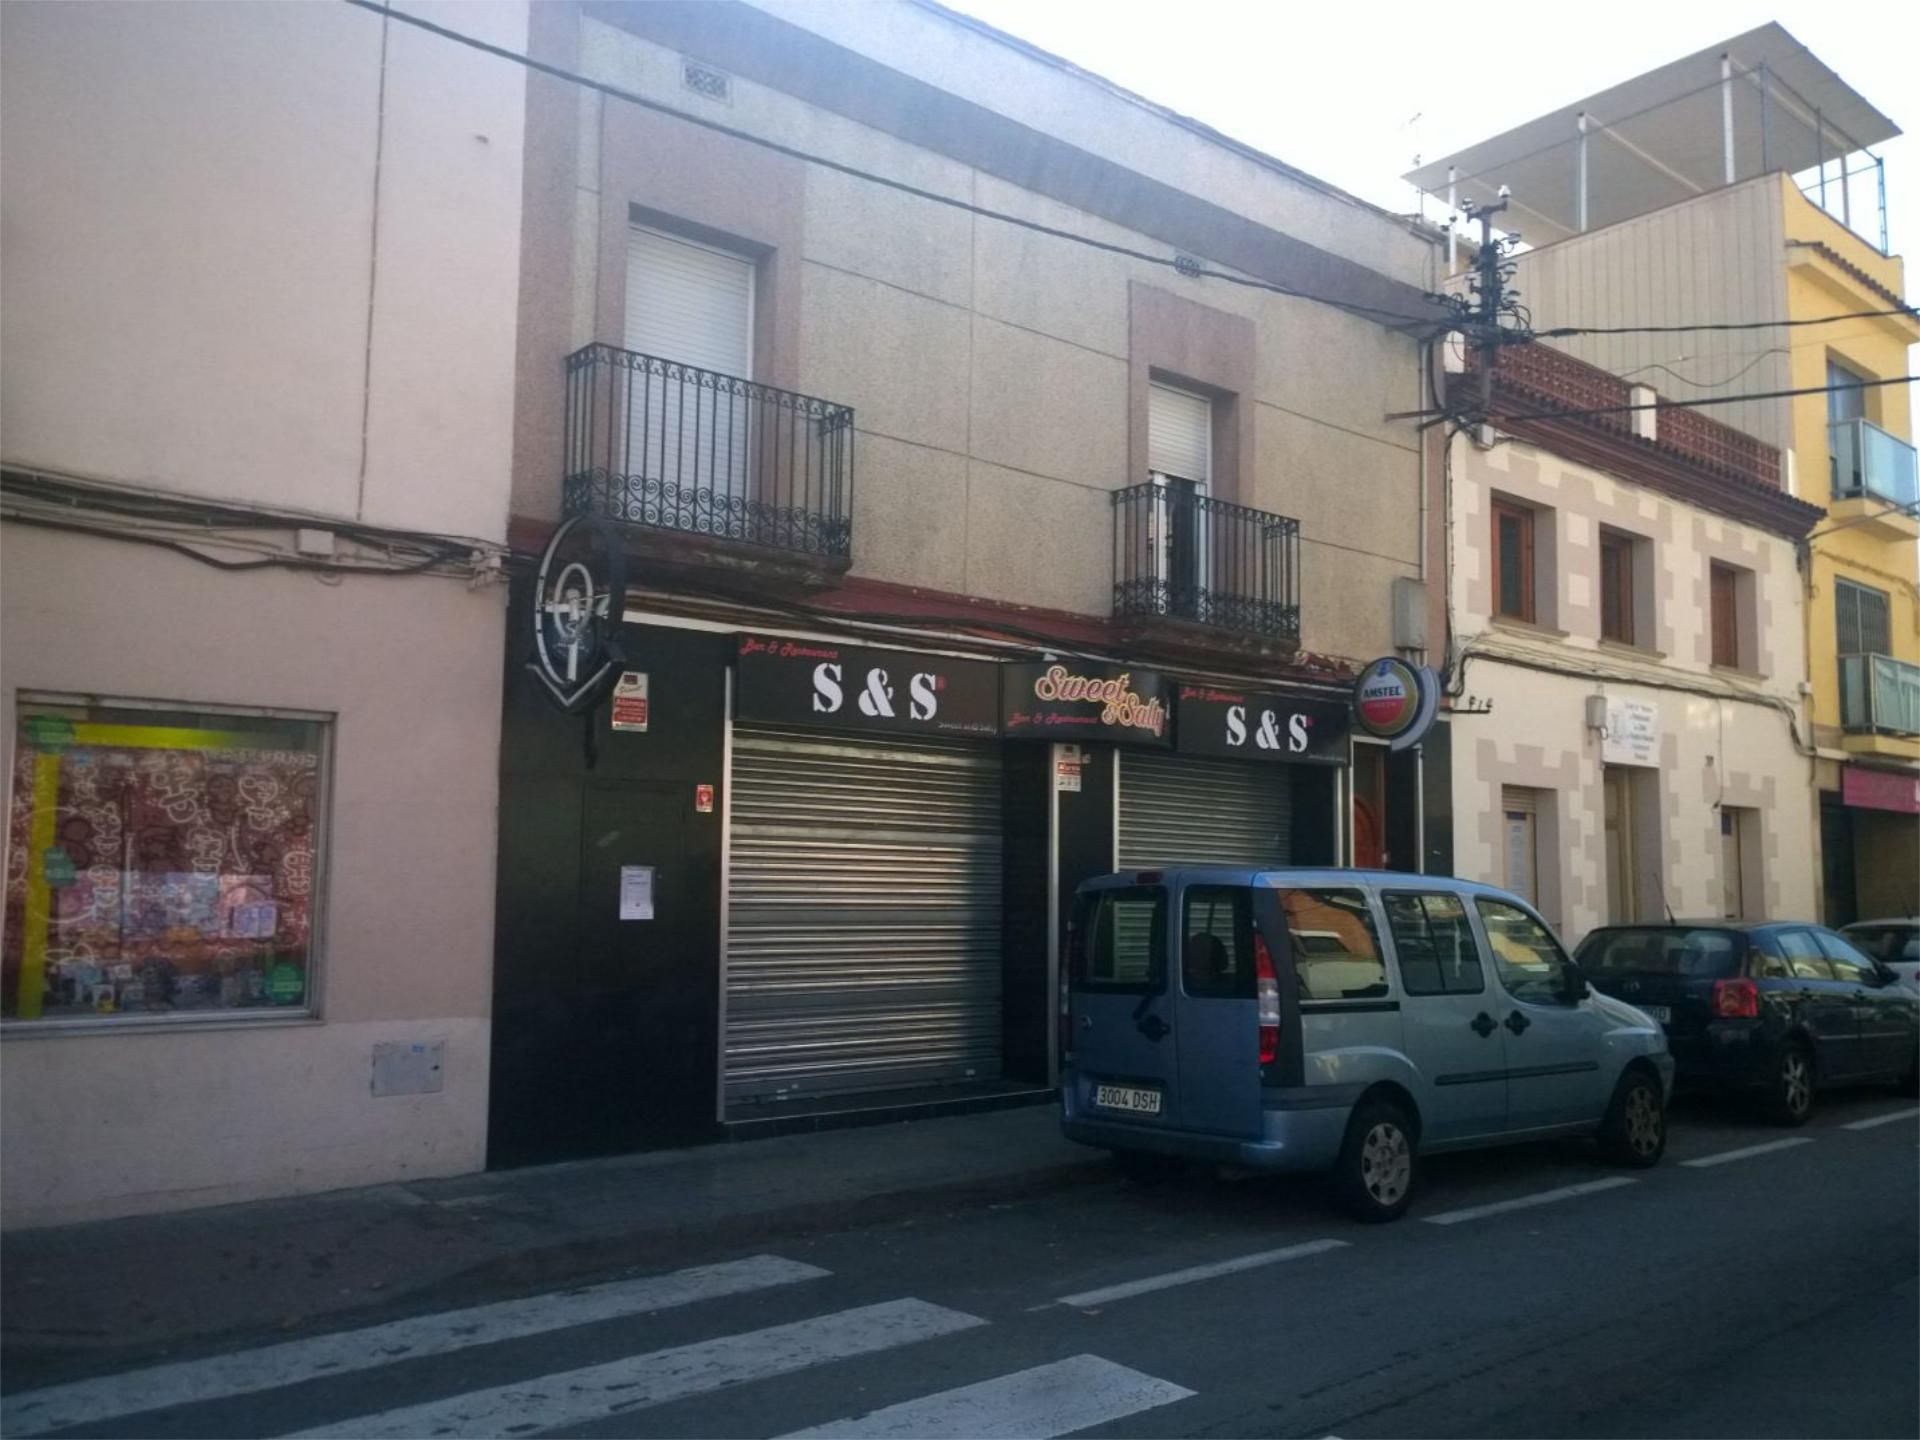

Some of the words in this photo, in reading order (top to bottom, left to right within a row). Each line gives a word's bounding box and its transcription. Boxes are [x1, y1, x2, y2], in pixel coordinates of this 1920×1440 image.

[813, 662, 843, 713] S
[858, 668, 895, 717] &
[1035, 665, 1130, 702] Sweet
[1363, 686, 1402, 698] AMSTEL
[1118, 692, 1165, 737] Salty
[1226, 705, 1247, 746] S
[1256, 710, 1280, 750] &
[1099, 1088, 1128, 1106] 3004
[1133, 1091, 1158, 1110] DSH
